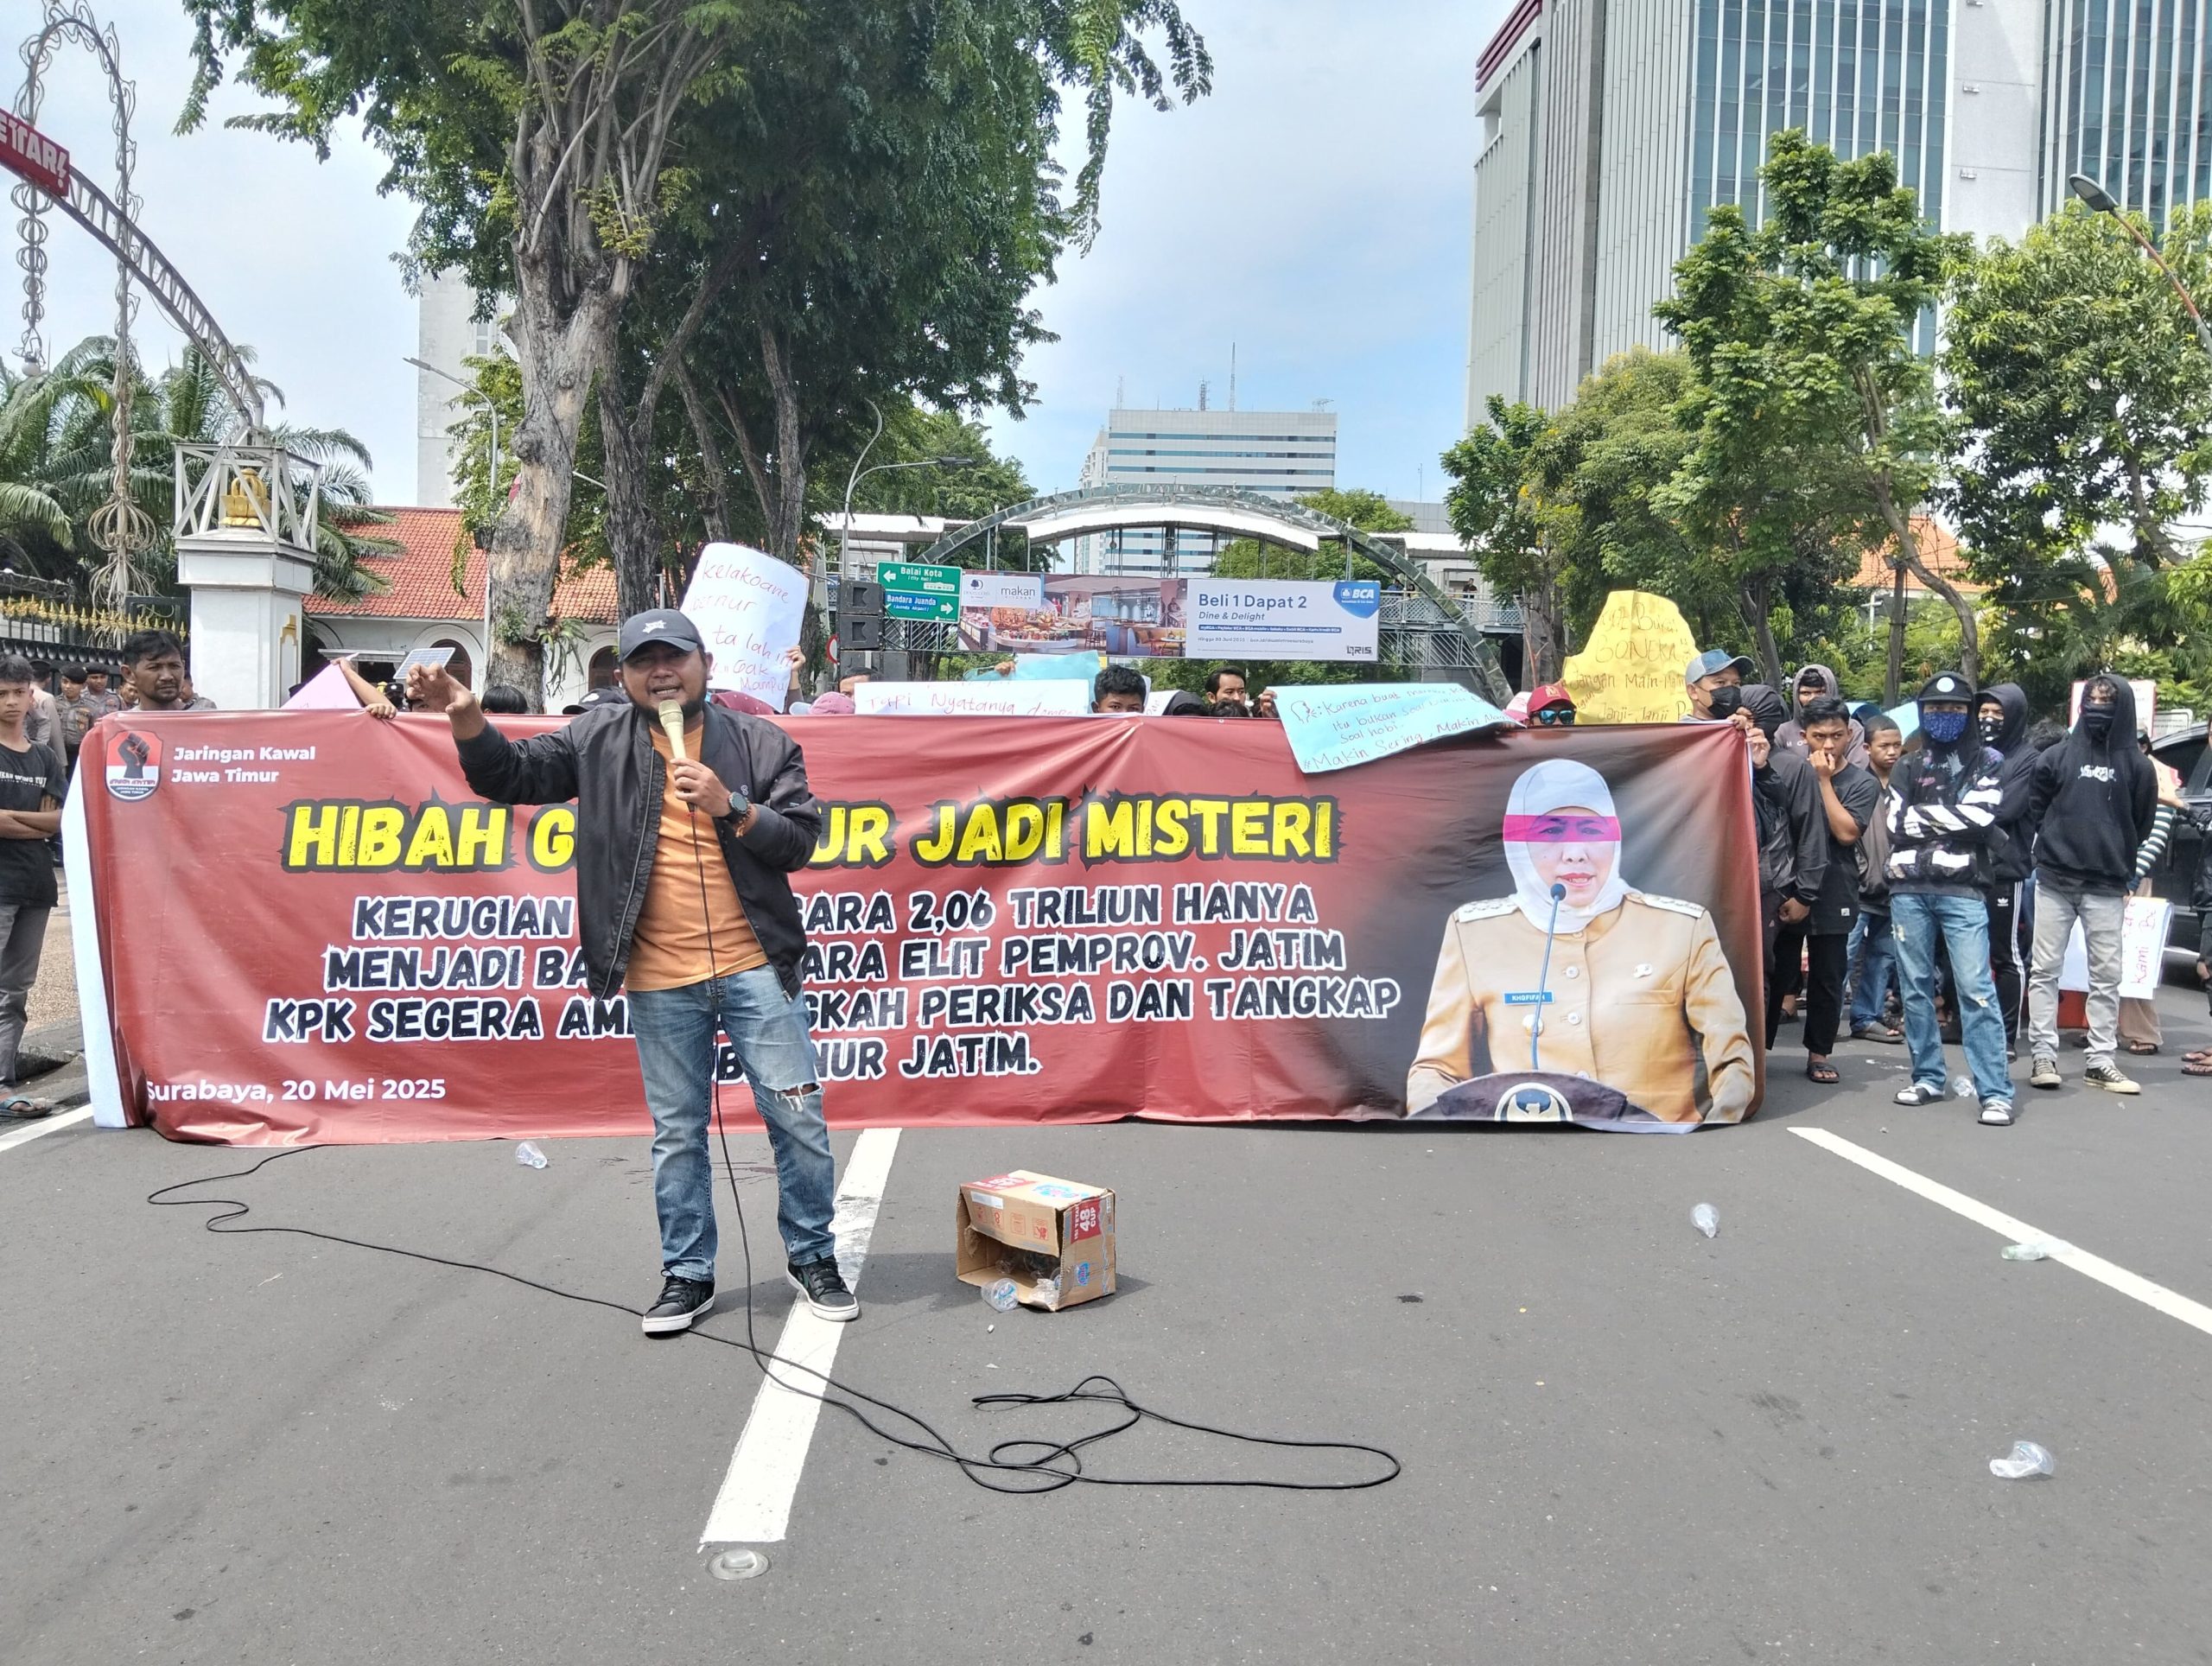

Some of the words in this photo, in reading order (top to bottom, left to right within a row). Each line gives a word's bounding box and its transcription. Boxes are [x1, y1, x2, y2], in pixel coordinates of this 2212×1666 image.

[900, 566, 921, 576] Balai
[924, 568, 943, 578] Kota
[887, 595, 912, 604] Bandara
[914, 595, 937, 606] Juanda
[1001, 585, 1035, 597] makan
[1351, 588, 1375, 599] BCA
[1198, 593, 1229, 607] Beli
[1233, 595, 1239, 607] 1
[1244, 595, 1294, 610] Dapat
[1298, 596, 1307, 608] 2
[1198, 611, 1220, 620] Dine
[1222, 612, 1229, 620] &
[1231, 612, 1265, 622] Delight
[174, 745, 255, 764] Jaringan
[259, 746, 316, 761] Kawal
[171, 768, 219, 783] Jawa
[225, 767, 279, 783] Timur
[288, 805, 507, 867] HIBAH
[916, 803, 1065, 862] JADI
[1085, 799, 1332, 858] MISTERI
[355, 897, 574, 938] KERUGIAN
[910, 892, 993, 934] 2,06
[1011, 887, 1160, 926] TRILIUN
[1175, 883, 1317, 922] HANYA
[327, 949, 523, 989] MENJADI
[902, 939, 990, 977] ELIT
[1004, 933, 1207, 976] PEMPROV.
[1220, 932, 1344, 970] JATIM
[266, 1002, 353, 1040] KPK
[369, 1000, 543, 1039] SEGERA
[921, 984, 1094, 1026] PERIKSA
[1109, 982, 1192, 1020] DAN
[1208, 980, 1399, 1017] TANGKAP
[901, 1036, 1039, 1077] JATIM.
[147, 1079, 274, 1104] Surabaya,
[282, 1079, 316, 1101] 20
[324, 1078, 375, 1100] Mei
[381, 1078, 446, 1099] 2025
[1080, 1209, 1090, 1231] 48
